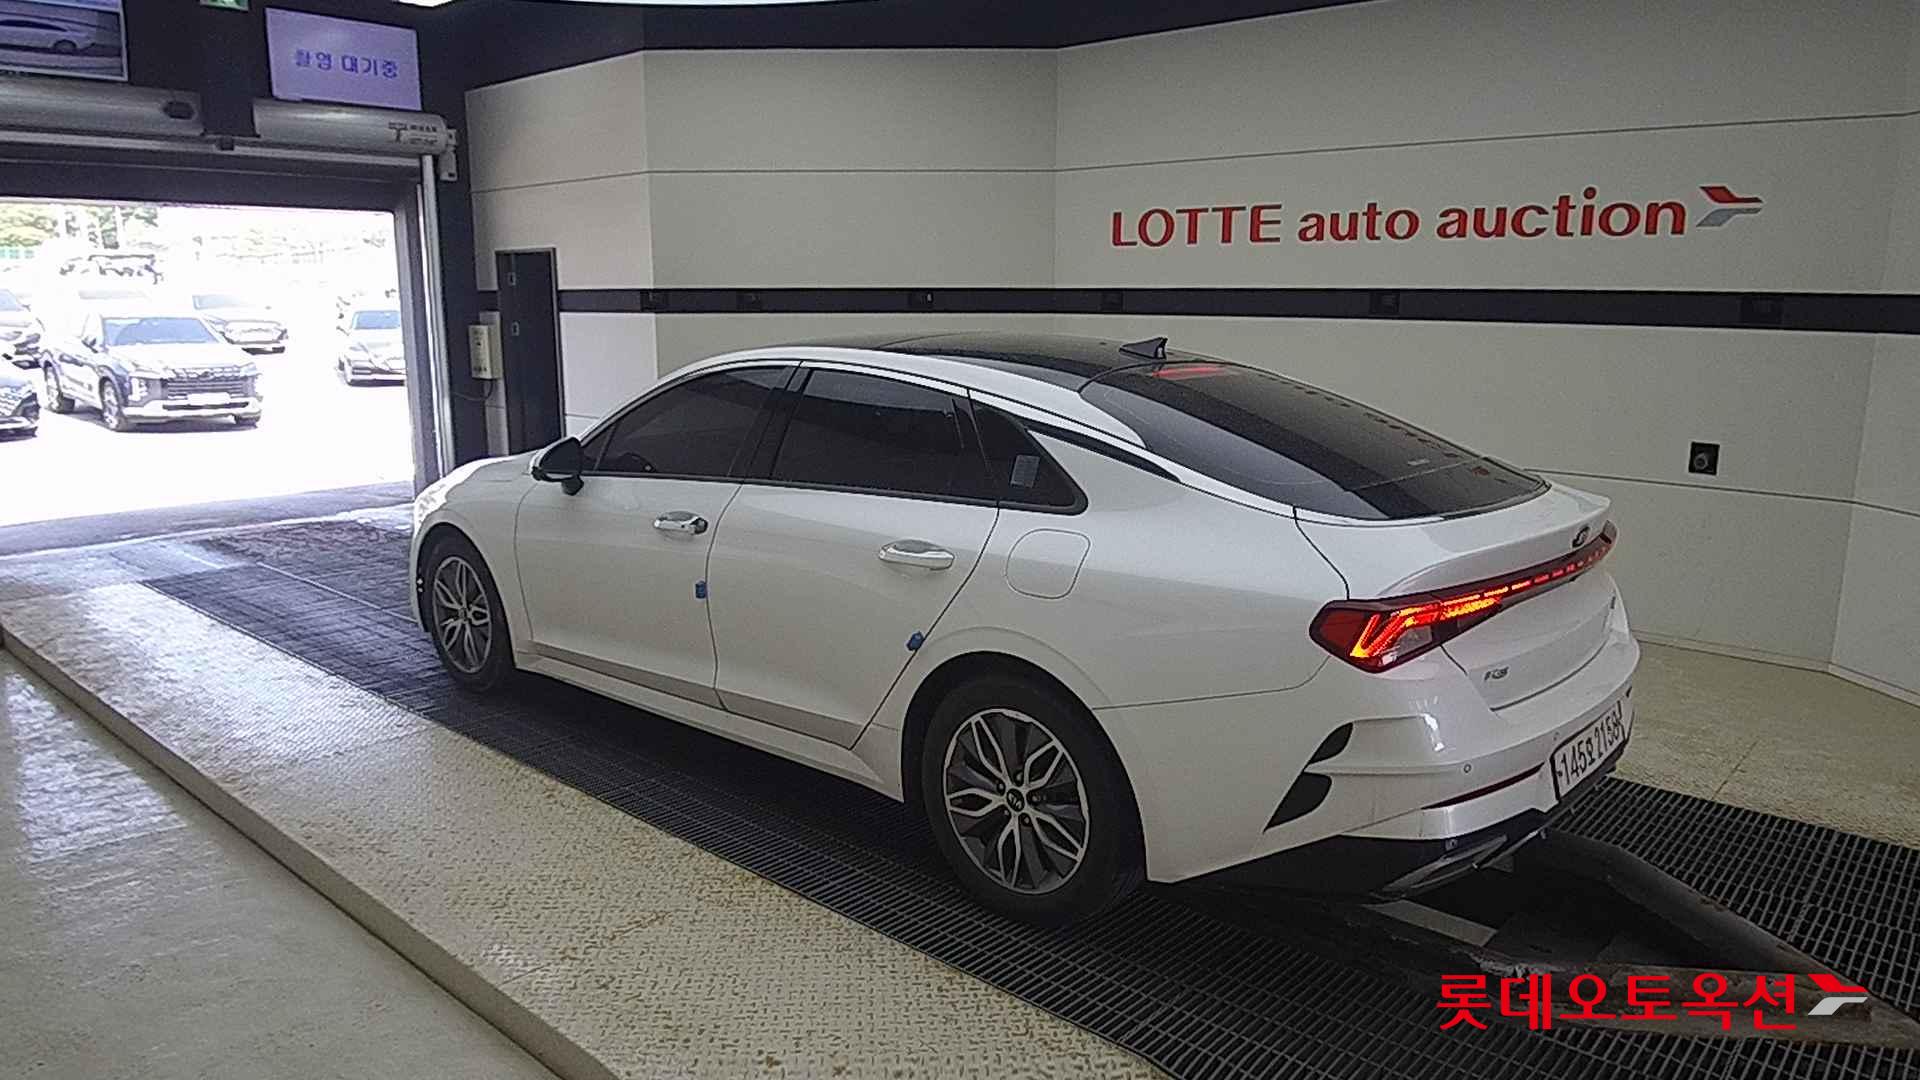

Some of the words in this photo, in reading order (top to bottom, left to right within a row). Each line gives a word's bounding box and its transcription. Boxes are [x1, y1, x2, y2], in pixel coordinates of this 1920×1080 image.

[341, 54, 398, 78] 대기중
[1112, 204, 1281, 247] LOTTE
[1298, 202, 1420, 242] auto
[1436, 186, 1686, 238] auction
